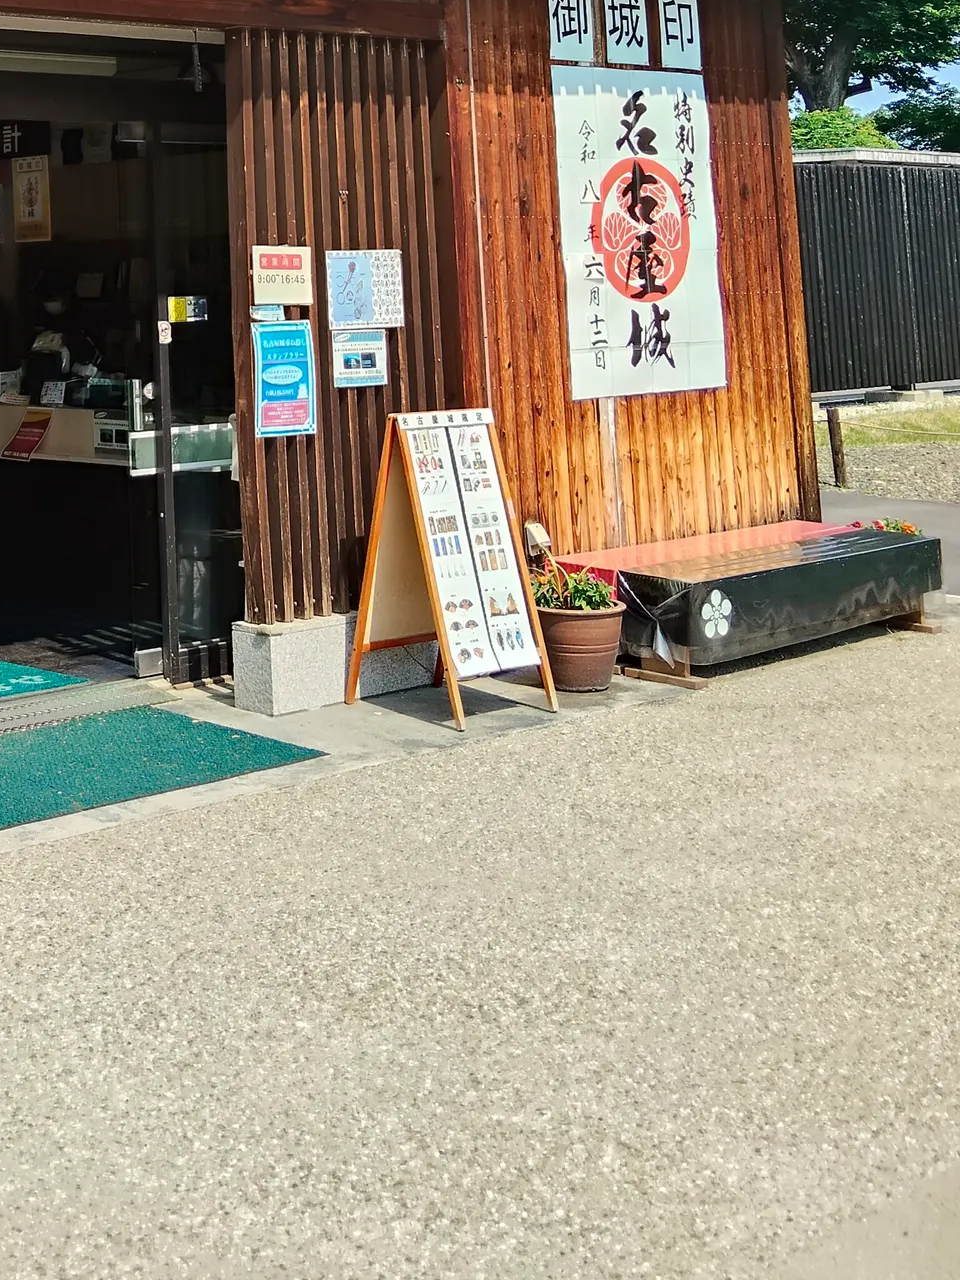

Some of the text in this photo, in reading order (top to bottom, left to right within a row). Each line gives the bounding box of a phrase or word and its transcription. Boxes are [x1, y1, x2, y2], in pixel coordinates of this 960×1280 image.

[260, 257, 301, 267] 営業時間
[615, 89, 676, 369] 名古屋城
